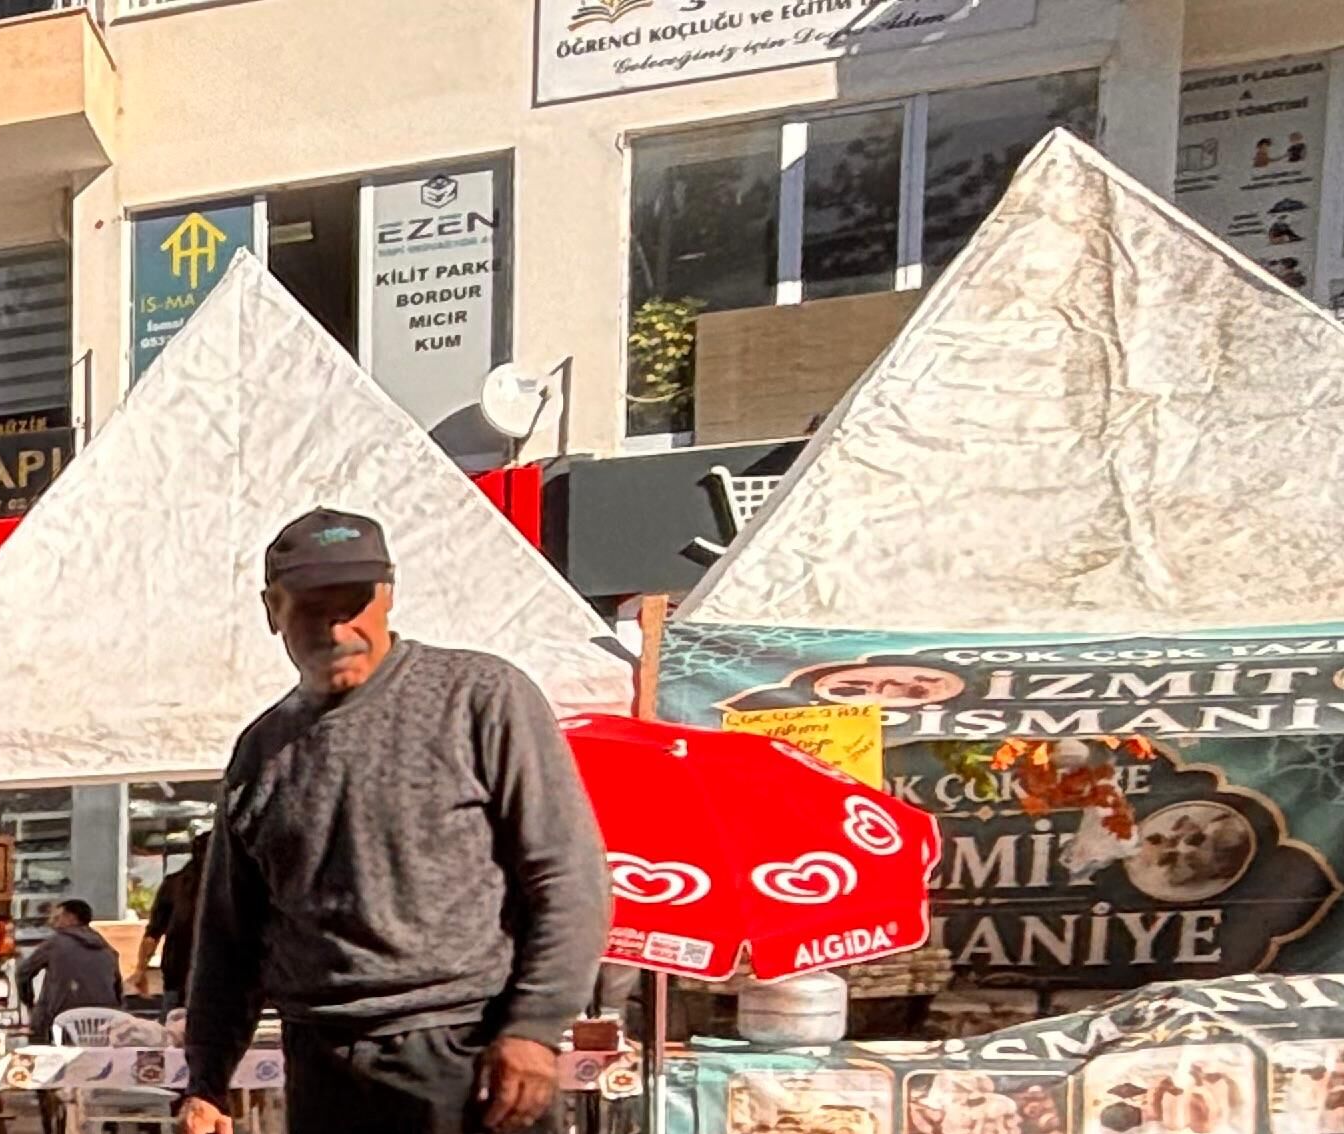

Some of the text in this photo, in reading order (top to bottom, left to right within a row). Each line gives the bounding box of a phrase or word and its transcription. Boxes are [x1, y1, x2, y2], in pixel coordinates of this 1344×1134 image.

[378, 208, 500, 246] EZEN
[414, 334, 462, 353] KUM
[982, 662, 1320, 700] İZMİT
